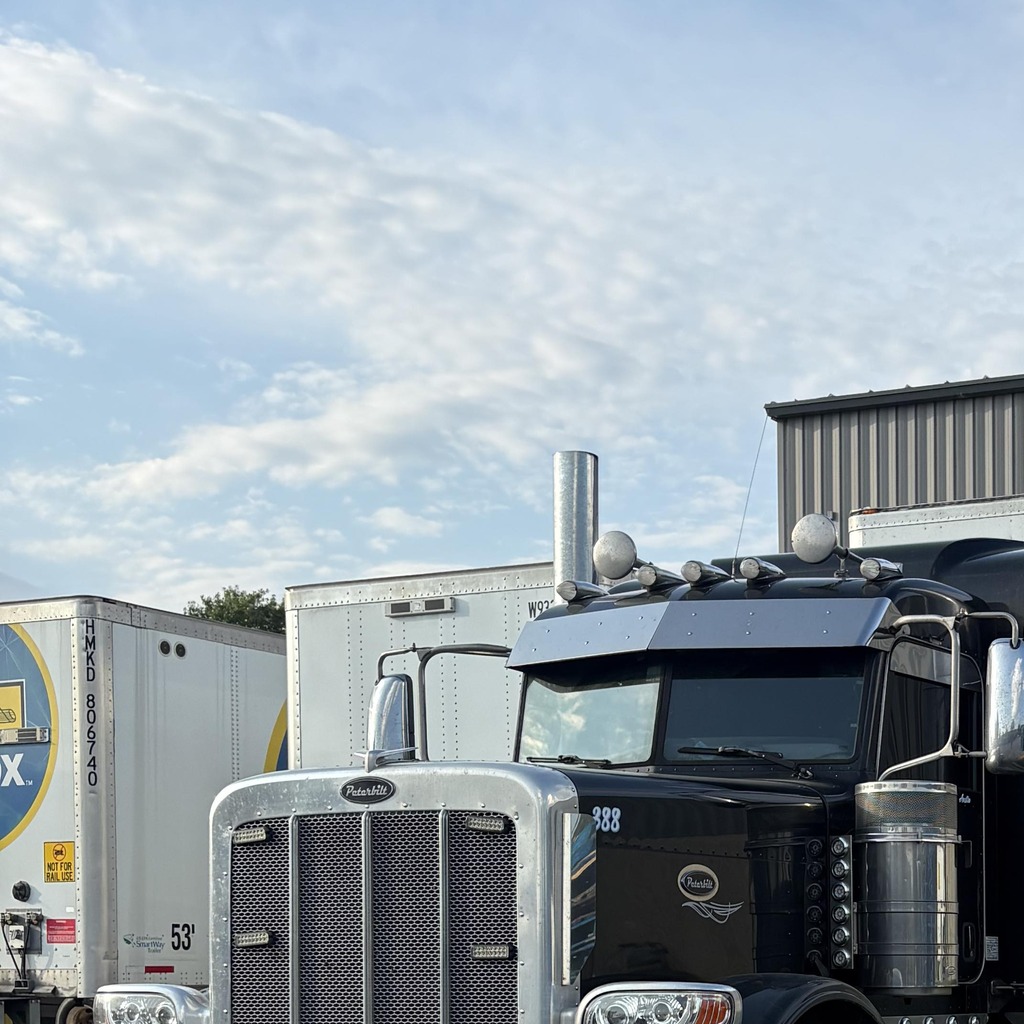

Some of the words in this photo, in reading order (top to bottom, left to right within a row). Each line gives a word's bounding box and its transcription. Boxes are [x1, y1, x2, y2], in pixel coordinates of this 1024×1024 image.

[85, 619, 96, 682] HMKD
[86, 694, 98, 786] 806740
[346, 784, 388, 797] Peterbilt
[47, 862, 59, 871] NOT
[60, 862, 72, 871] FOR
[46, 872, 60, 881] RAIL
[61, 872, 73, 881] USE
[686, 876, 713, 889] Peterbilt
[171, 923, 195, 950] 53'
[136, 941, 166, 950] SmartWay
